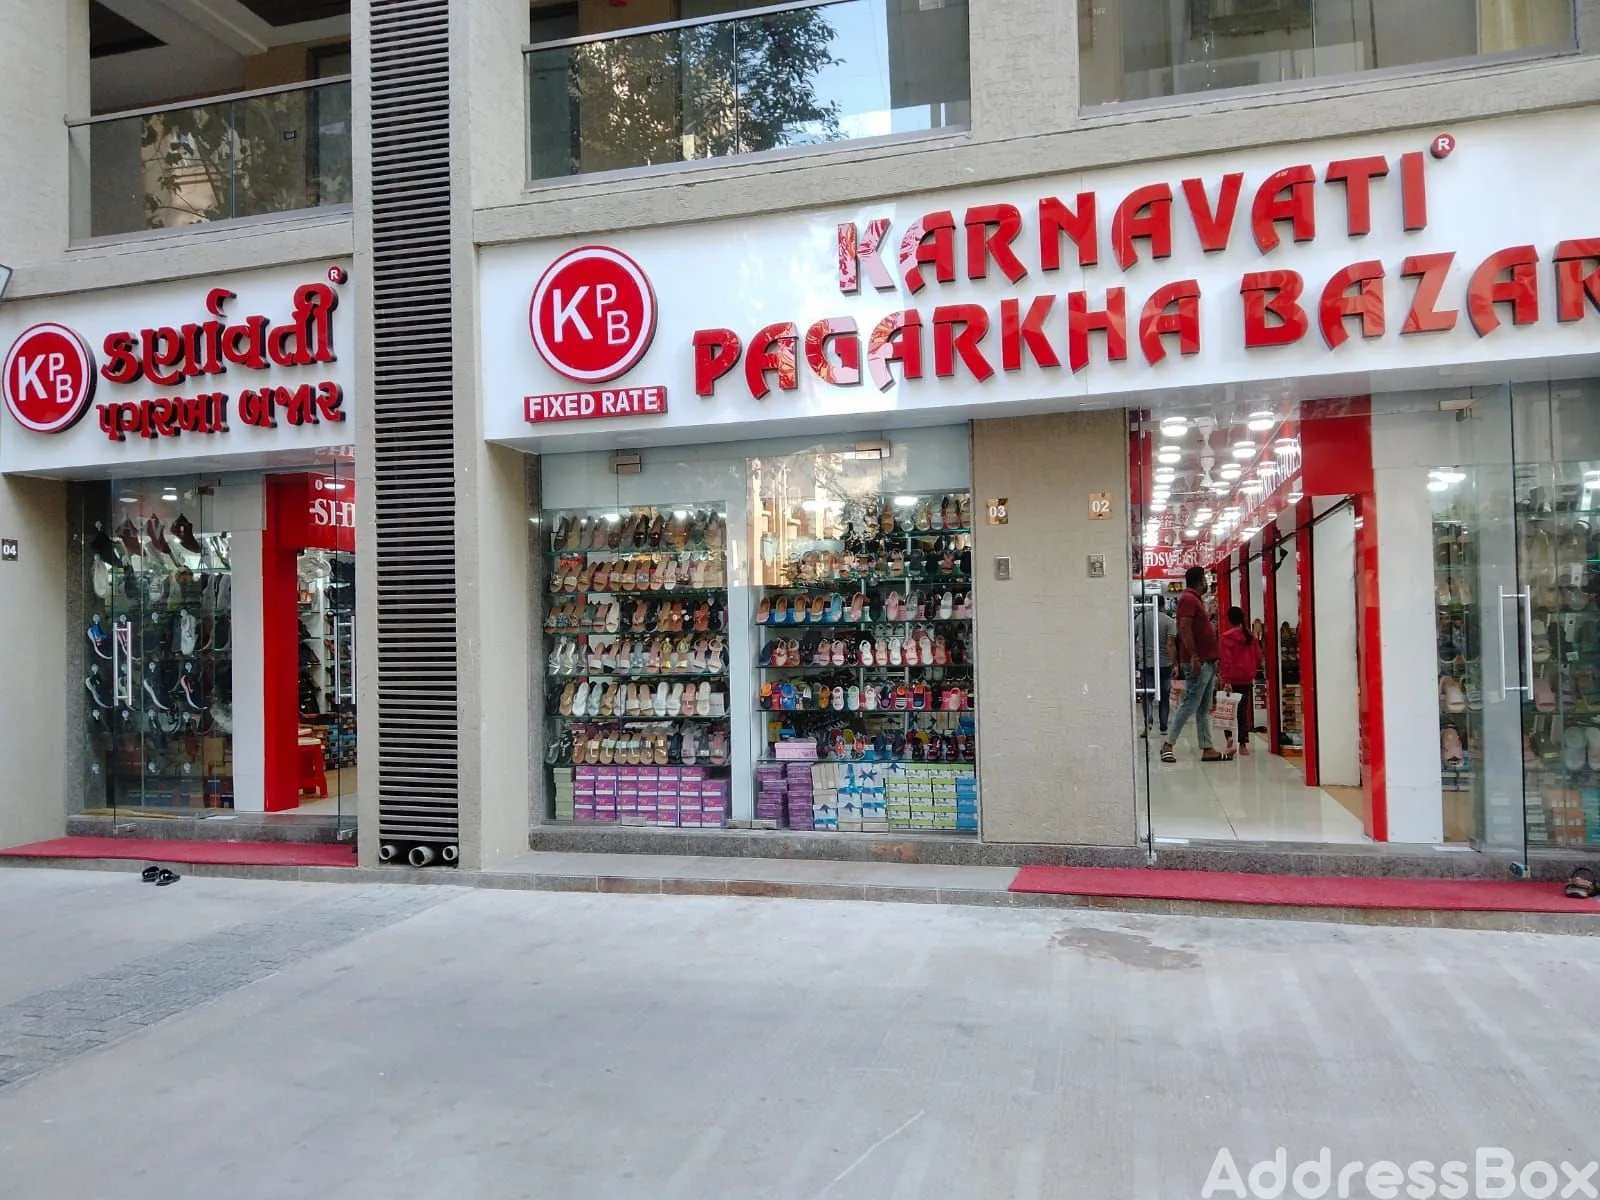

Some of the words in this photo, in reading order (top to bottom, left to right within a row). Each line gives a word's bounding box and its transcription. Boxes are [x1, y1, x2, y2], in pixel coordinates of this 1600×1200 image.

[838, 151, 1428, 296] KARNAVATI
[692, 279, 1201, 400] PAGARKHA
[1240, 237, 1600, 351] BAZAR
[528, 393, 595, 419] FIXED
[601, 388, 659, 415] RATE
[989, 505, 1006, 518] 03
[1091, 500, 1110, 513] 02
[3, 544, 17, 556] 04
